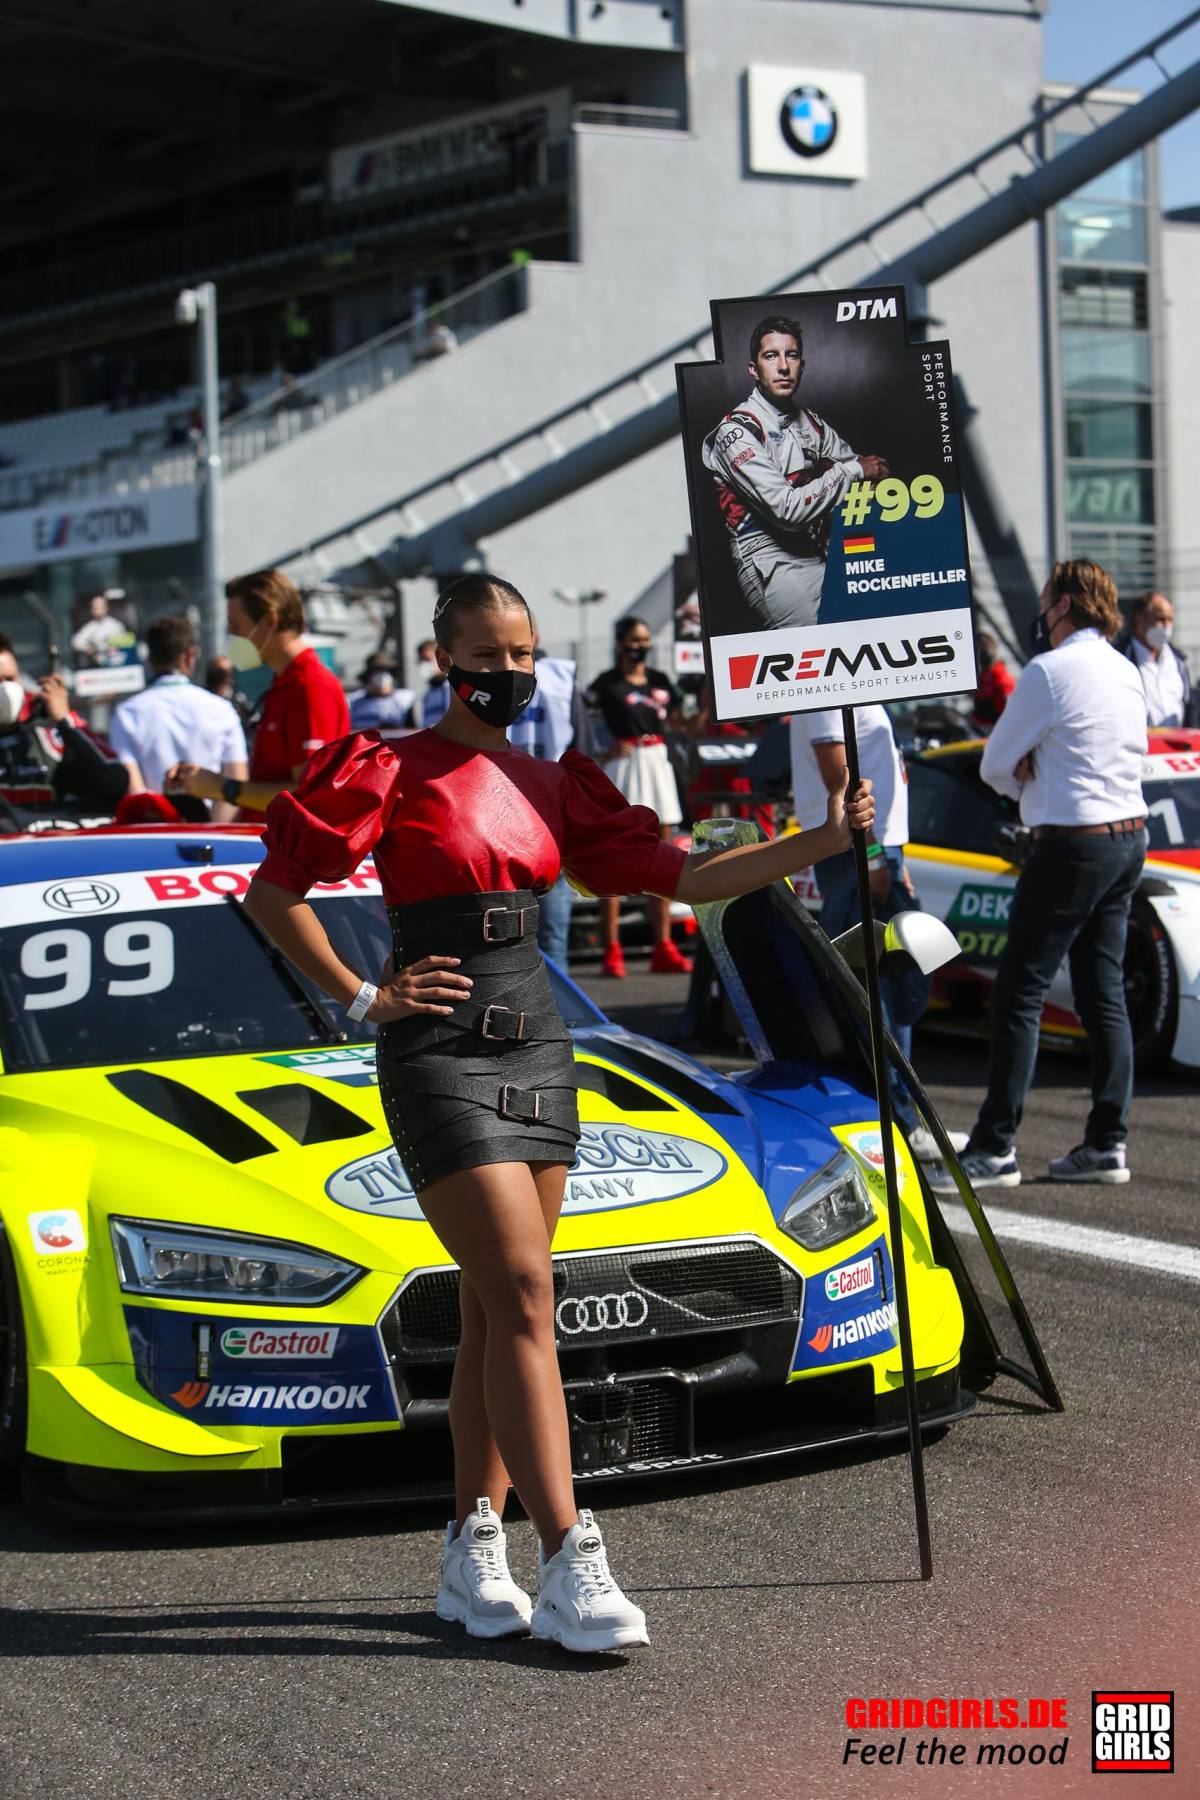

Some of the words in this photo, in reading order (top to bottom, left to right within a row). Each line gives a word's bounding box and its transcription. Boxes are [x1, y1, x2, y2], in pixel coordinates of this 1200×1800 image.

[836, 298, 897, 322] DTM
[922, 354, 935, 401] SPORT
[934, 353, 952, 463] PERFORMANCE
[841, 474, 944, 526] #99
[845, 559, 885, 575] MIKE
[847, 568, 966, 594] ROCKENFELLER
[755, 634, 956, 685] REMUS
[756, 683, 846, 700] PERFORMANCE
[851, 677, 889, 690] SPORT
[895, 669, 957, 684] EXHAUSTS
[20, 920, 174, 1011] 99
[840, 1262, 872, 1294] Castrol
[250, 1331, 330, 1354] Castrol
